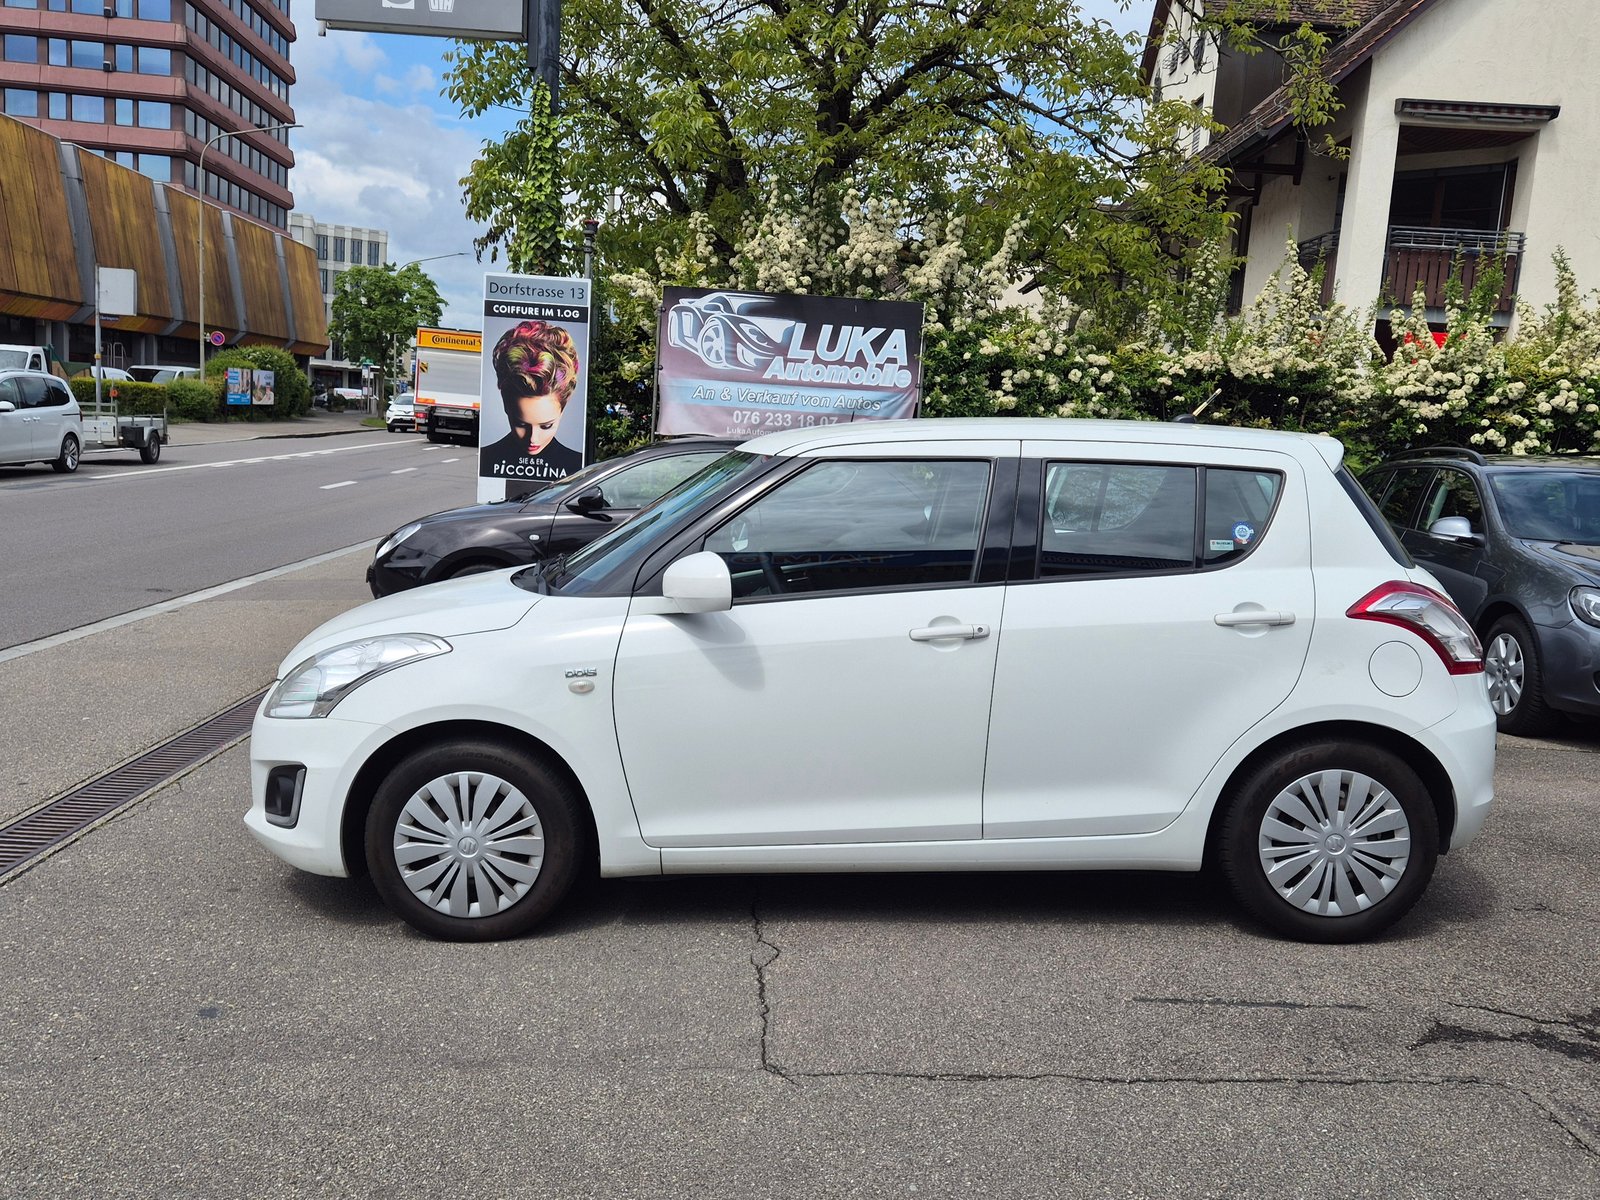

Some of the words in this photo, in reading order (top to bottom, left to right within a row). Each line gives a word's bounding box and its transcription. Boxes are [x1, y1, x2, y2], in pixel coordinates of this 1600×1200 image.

[489, 282, 565, 298] Dorfstrasse
[570, 287, 585, 300] 13
[493, 304, 540, 316] COIFFURE
[541, 308, 554, 317] IM
[556, 309, 580, 319] 1.OG
[432, 335, 476, 346] Continental
[787, 322, 908, 366] LUKA
[762, 356, 912, 388] Automobile
[692, 385, 716, 401] An
[720, 387, 732, 401] &
[737, 388, 799, 406] Verkauf
[801, 395, 831, 408] von
[833, 395, 882, 412] Autos
[733, 410, 760, 425] 076
[764, 412, 792, 427] 233
[797, 414, 815, 428] 18
[518, 457, 529, 465] SIE
[529, 457, 535, 465] &
[535, 458, 544, 466] ER
